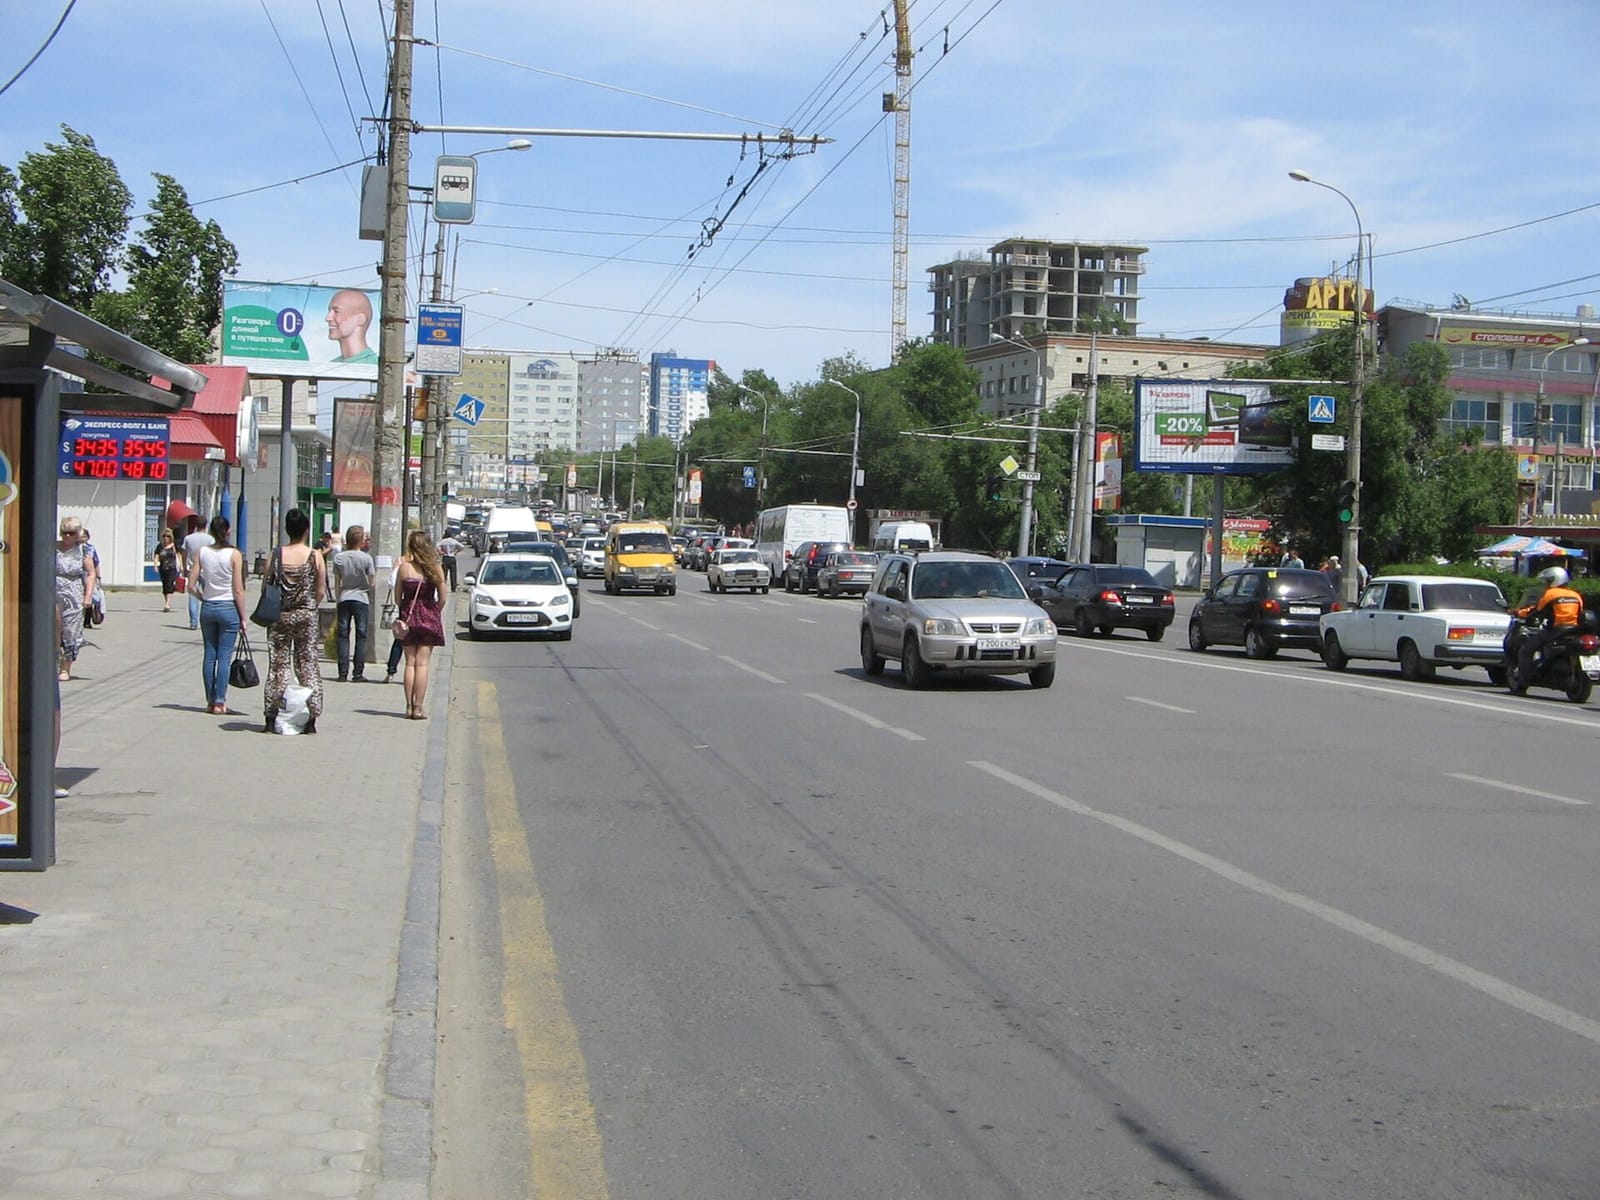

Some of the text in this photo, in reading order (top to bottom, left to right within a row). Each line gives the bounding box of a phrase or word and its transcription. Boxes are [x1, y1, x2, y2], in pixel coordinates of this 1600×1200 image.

[1306, 279, 1367, 310] АРГО
[231, 315, 271, 326] Разговоры
[283, 311, 296, 333] 0
[231, 325, 259, 334] длиной
[237, 335, 285, 344] путешествие
[1475, 333, 1526, 343] СТОЛОВАЯ
[84, 421, 147, 430] ЭКСПРЕСС-ВОЛГА
[1159, 417, 1204, 432] -20%
[129, 433, 159, 441] продажа
[75, 438, 118, 457] 3435
[123, 440, 167, 458] 3545
[73, 459, 118, 478] 4700
